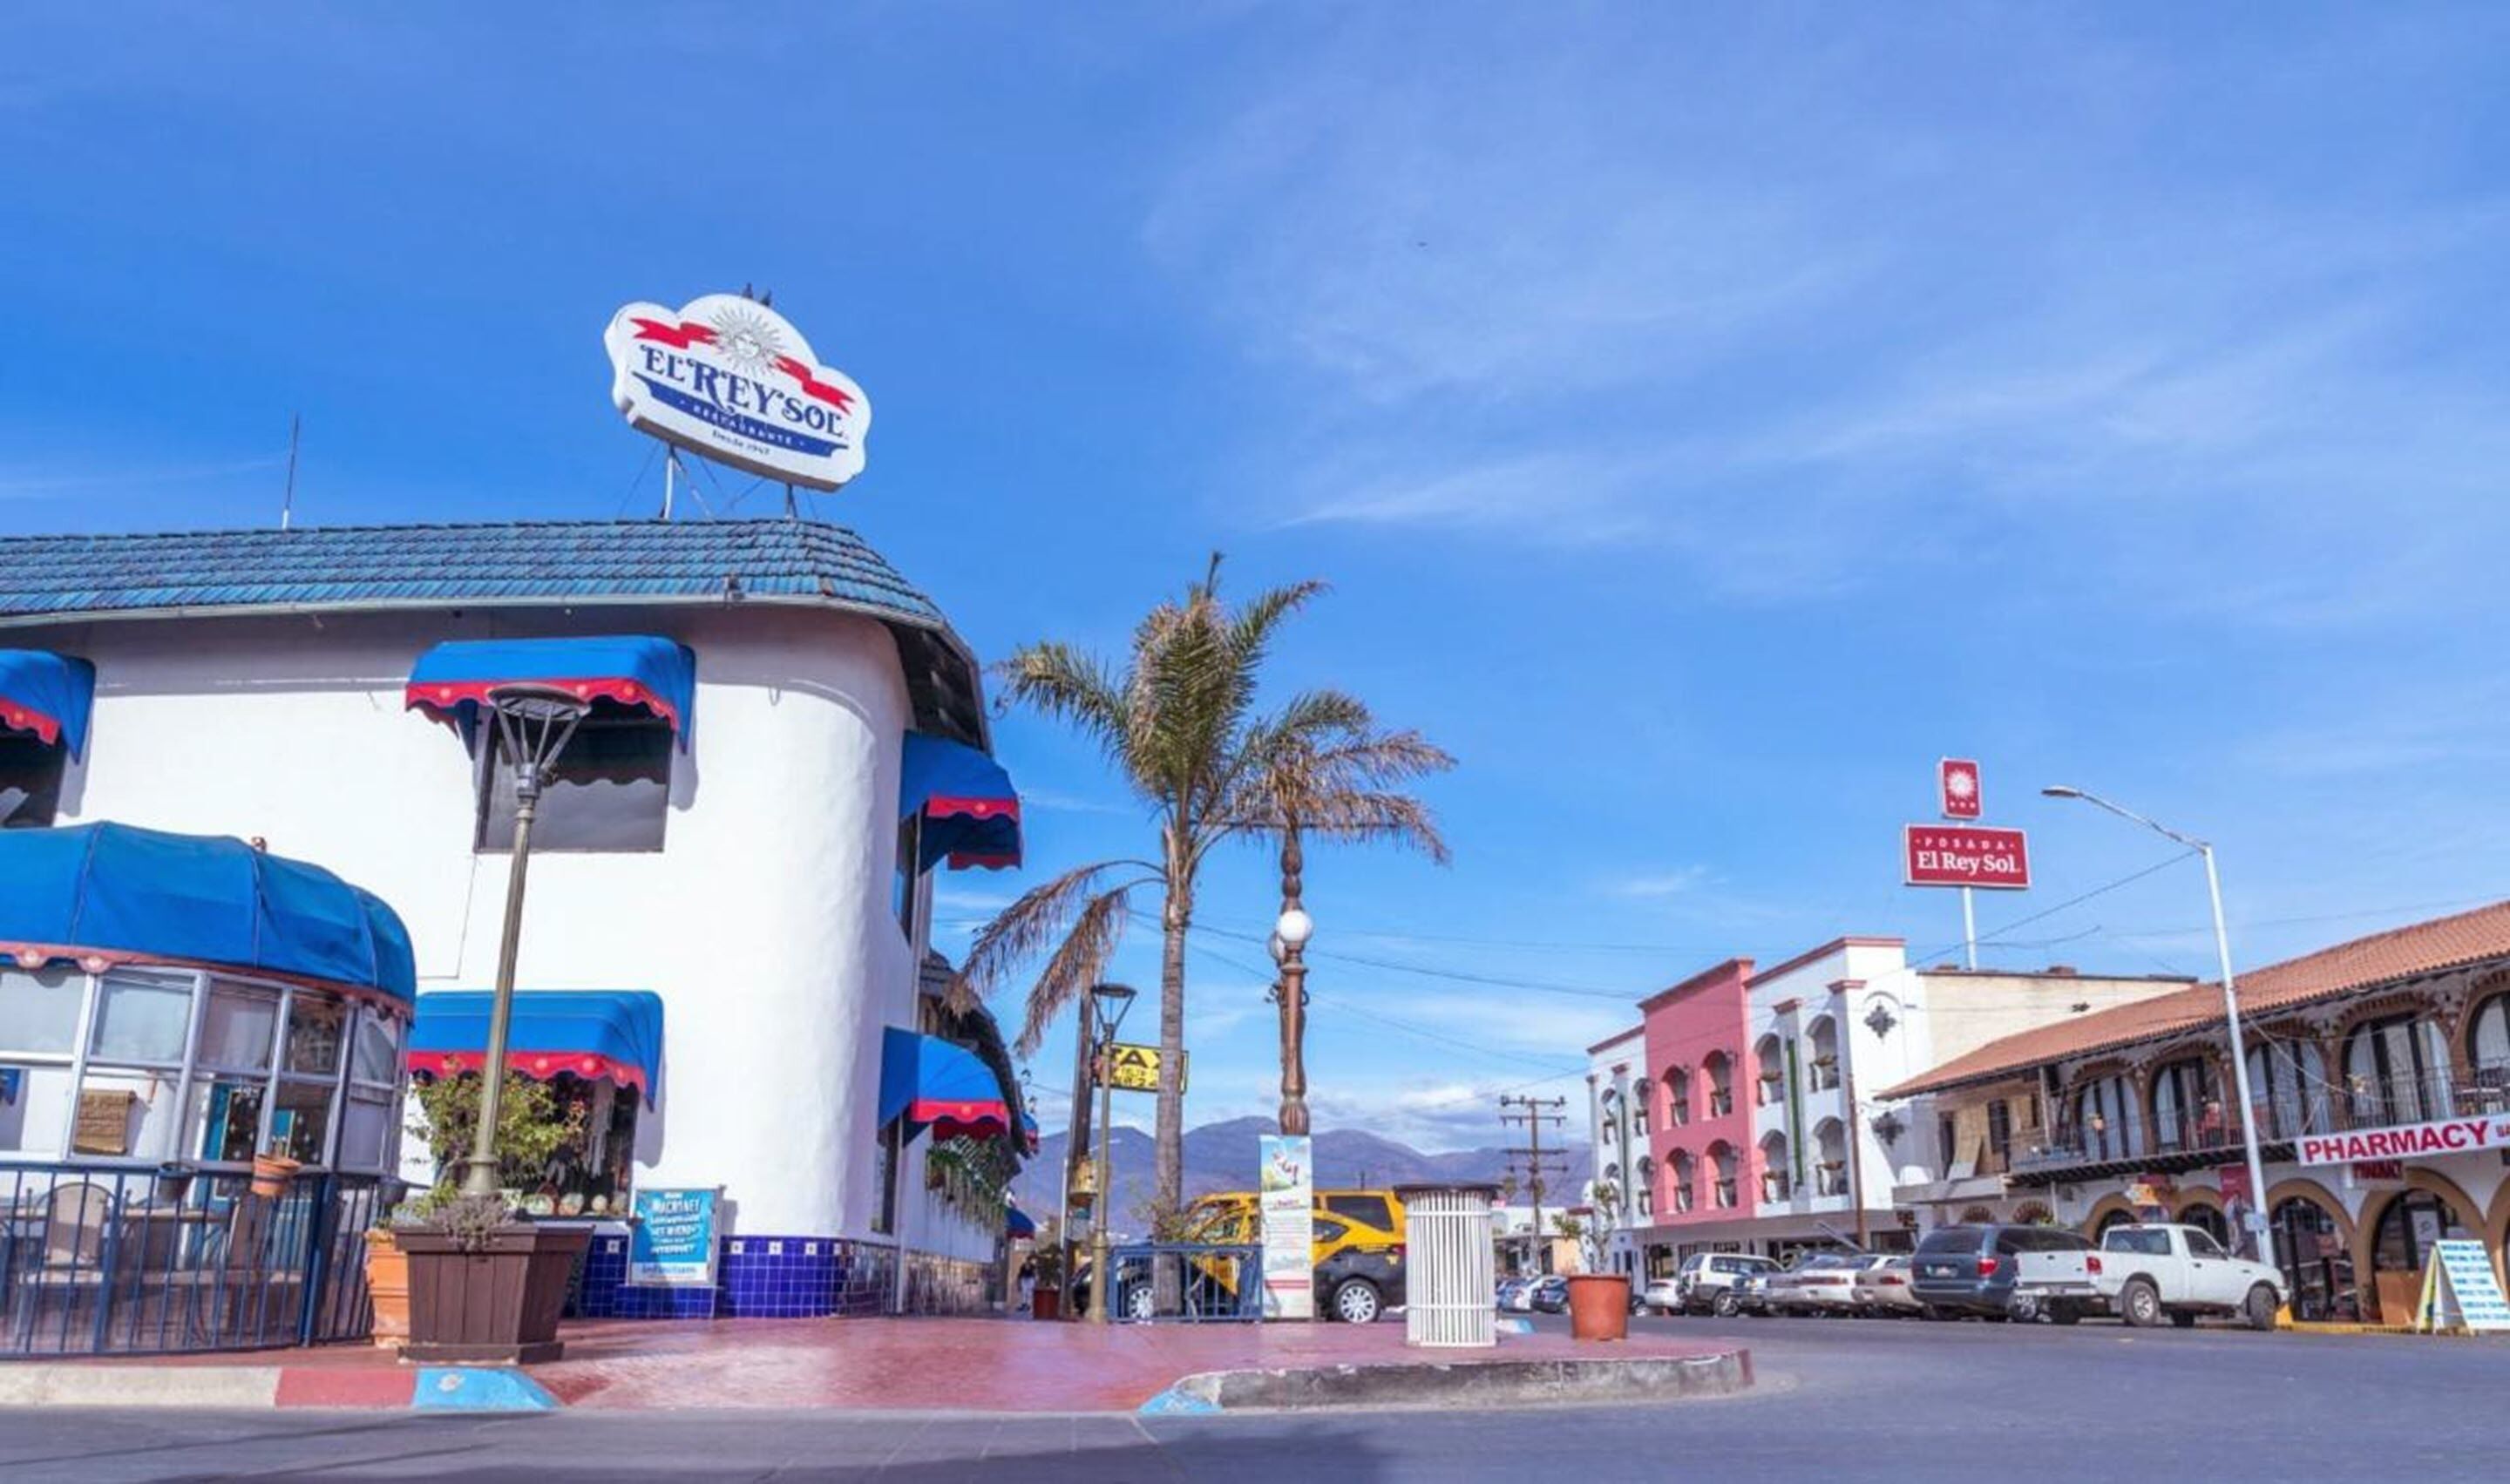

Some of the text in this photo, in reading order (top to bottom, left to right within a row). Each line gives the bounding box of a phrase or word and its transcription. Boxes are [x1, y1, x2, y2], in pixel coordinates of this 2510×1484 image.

[640, 344, 845, 438] EL REY SOL
[1924, 837, 2005, 850] POSADA
[1916, 850, 2016, 877] El Rey Sol
[2303, 1121, 2489, 1163] PHARMACY
